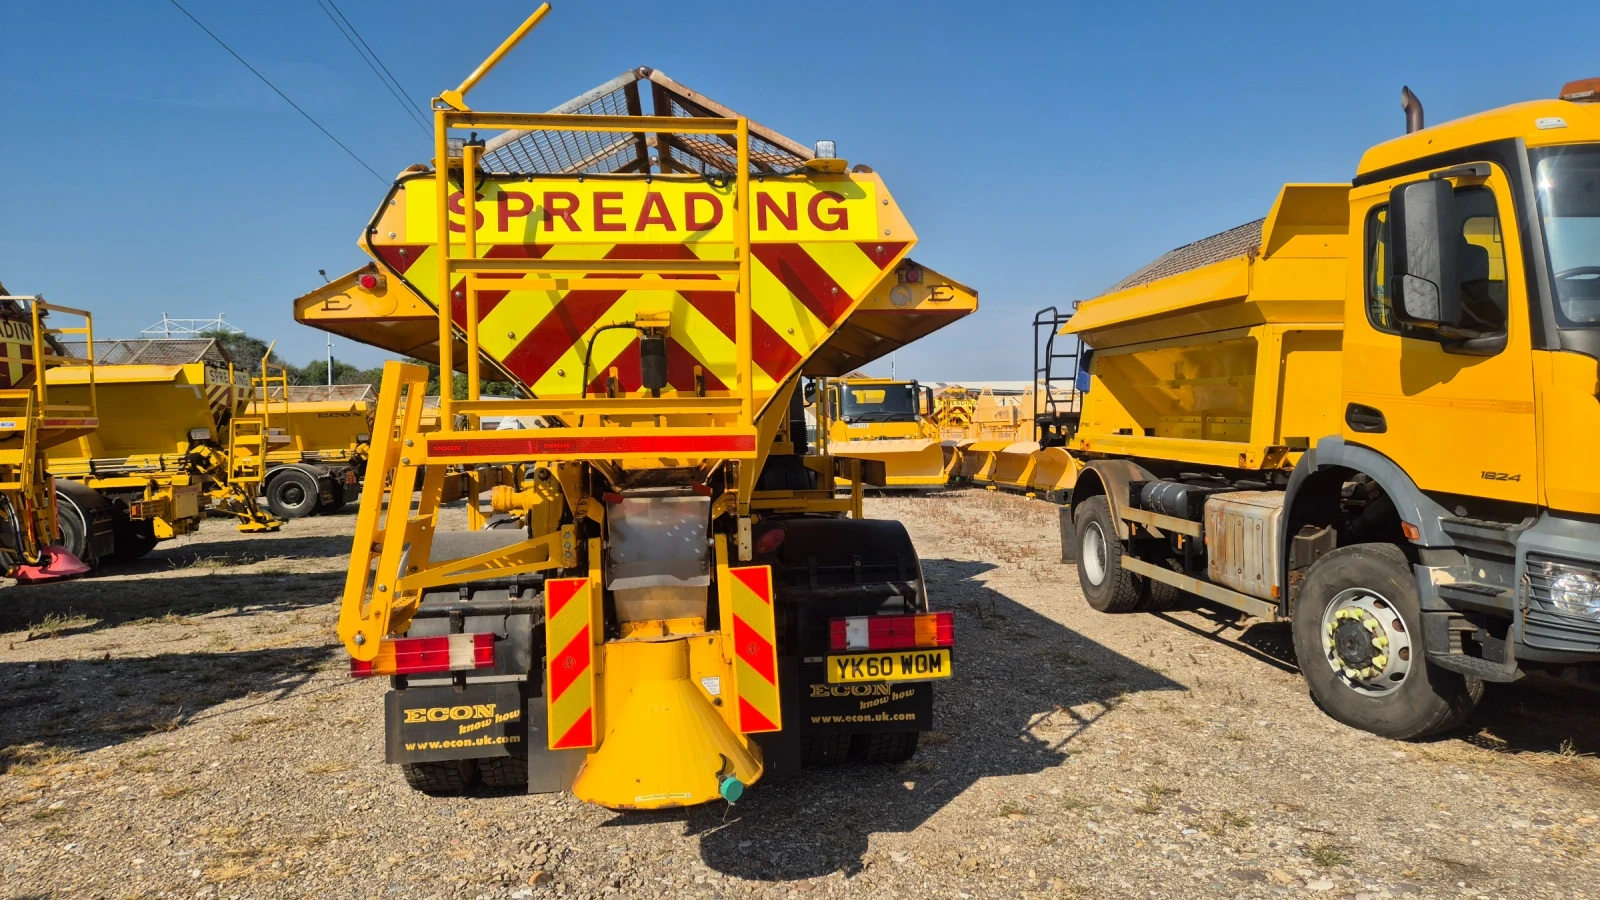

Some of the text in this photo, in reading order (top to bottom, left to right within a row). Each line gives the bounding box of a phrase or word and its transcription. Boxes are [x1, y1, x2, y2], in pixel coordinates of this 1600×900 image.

[448, 191, 849, 233] SPREADNG
[1481, 471, 1521, 482] 1824
[837, 653, 942, 679] YK60 WOM
[810, 684, 893, 698] ECON
[859, 688, 915, 711] know how
[404, 704, 496, 723] ECON
[459, 709, 520, 735] know how
[811, 712, 916, 724] www.econ.uk.com
[405, 735, 521, 751] www.econ.uk.com
